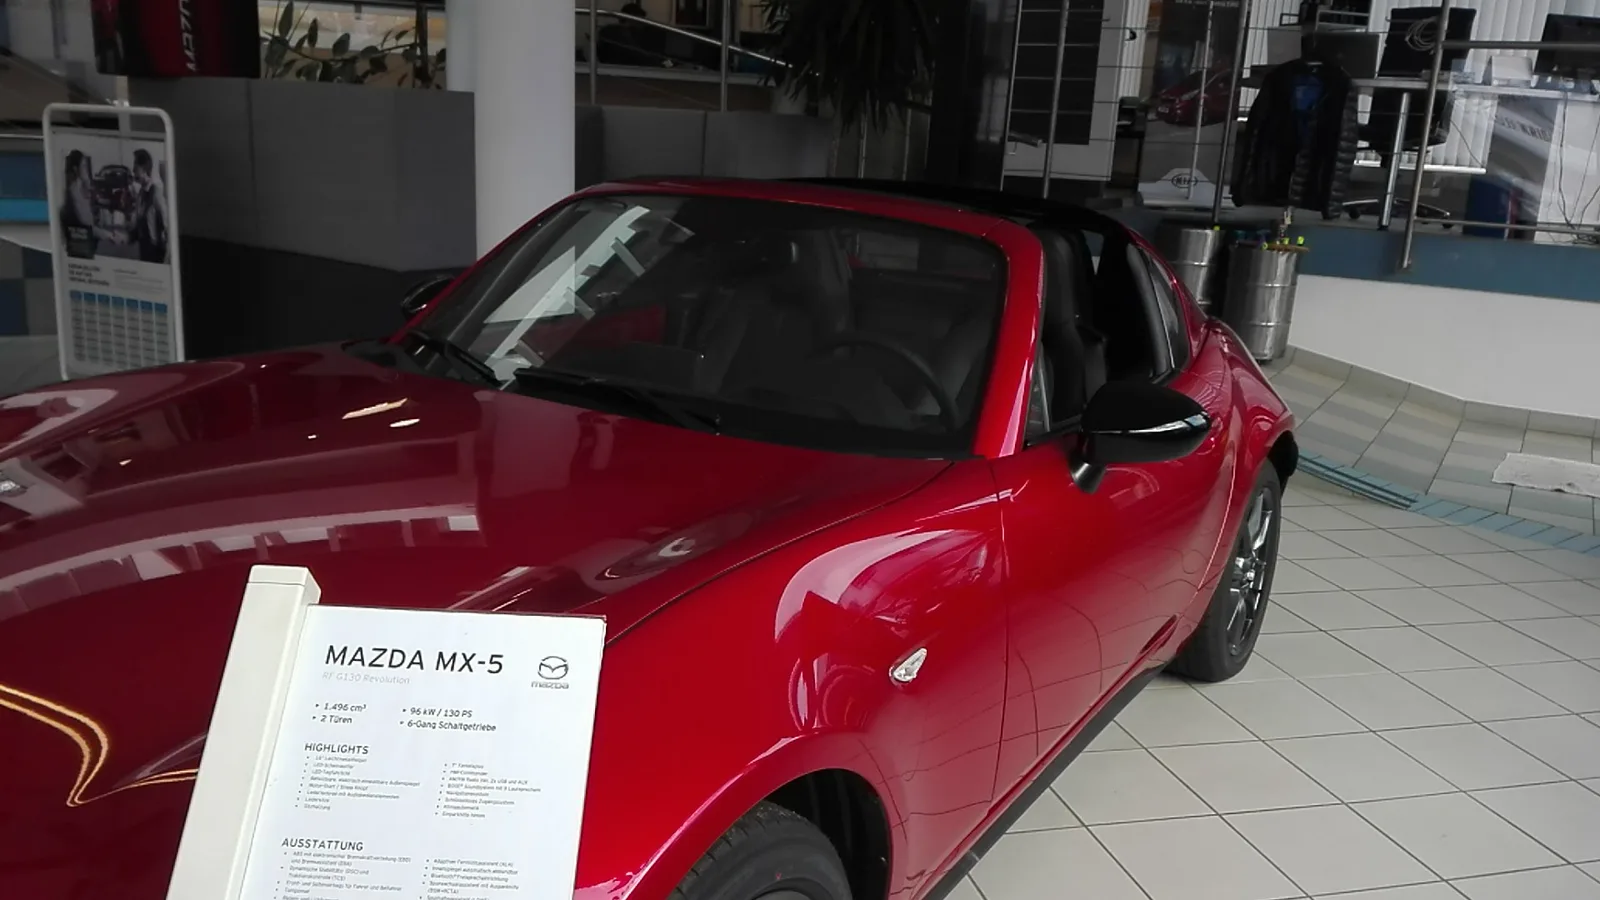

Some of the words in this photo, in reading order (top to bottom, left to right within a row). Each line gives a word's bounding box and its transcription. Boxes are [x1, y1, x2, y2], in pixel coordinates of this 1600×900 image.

[324, 644, 424, 670] MAZDA
[435, 651, 504, 674] MX-5
[322, 672, 333, 680] RF
[336, 672, 362, 682] G130
[363, 674, 410, 684] Revolution
[530, 681, 570, 690] mazda
[323, 702, 349, 712] 1.496
[410, 707, 422, 716] 96
[423, 708, 436, 717] kW
[443, 708, 460, 718] 130
[461, 709, 473, 718] PS
[320, 715, 328, 723] 2
[329, 715, 353, 724] Türen
[407, 719, 437, 730] 6-Gang
[438, 720, 497, 732] Schaltgetriebe
[304, 743, 369, 755] HIGHLIGHTS
[281, 838, 364, 851] AUSSTATTUNG
